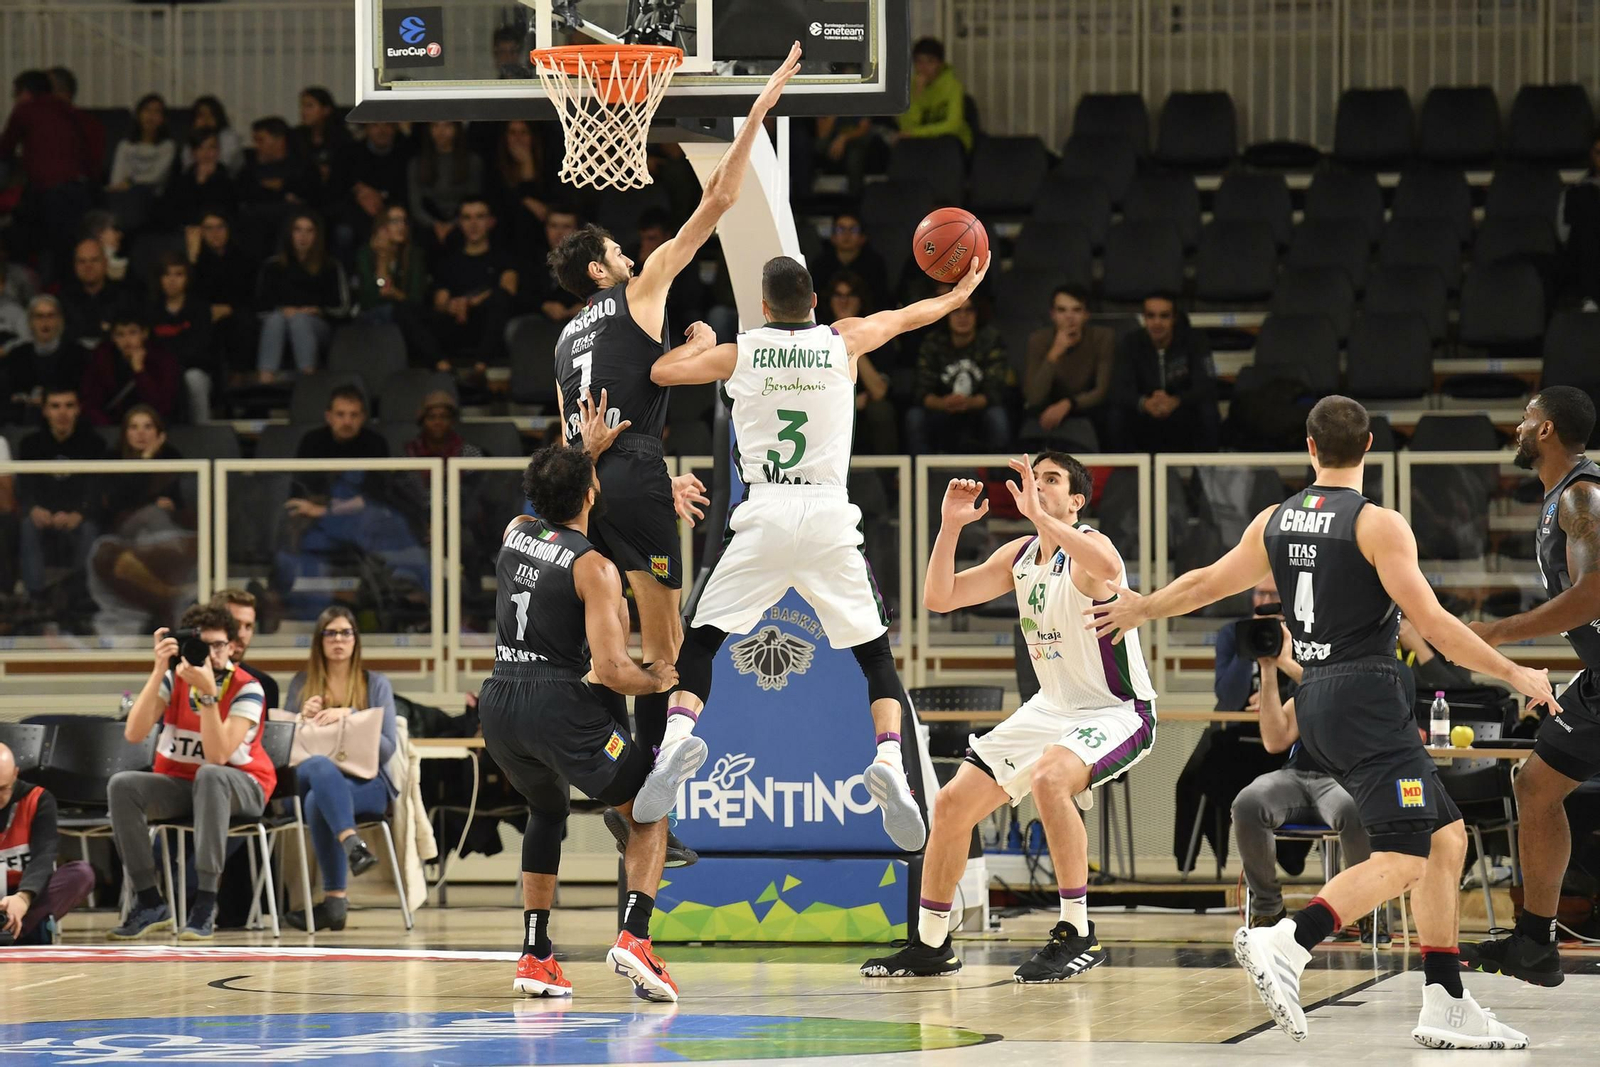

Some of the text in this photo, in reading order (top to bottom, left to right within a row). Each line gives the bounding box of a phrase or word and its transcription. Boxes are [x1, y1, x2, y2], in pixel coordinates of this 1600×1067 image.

[823, 27, 864, 36] oneteam
[387, 46, 427, 57] EuroCup
[571, 331, 597, 351] ITAS
[752, 344, 833, 369] FERNÁNDEZ
[572, 350, 592, 402] 7
[766, 408, 809, 469] 3
[1279, 508, 1336, 534] CRAFT
[555, 547, 575, 569] JR
[1288, 543, 1317, 559] ITAS
[515, 562, 540, 581] ITAS
[1289, 558, 1316, 568] MUTUA
[513, 575, 536, 589] MUTUA
[1027, 583, 1046, 615] 43
[1293, 571, 1315, 634] 4
[510, 590, 532, 641] 1
[771, 606, 826, 640] BASKET
[1077, 727, 1107, 749] 43
[1402, 786, 1422, 798] MD
